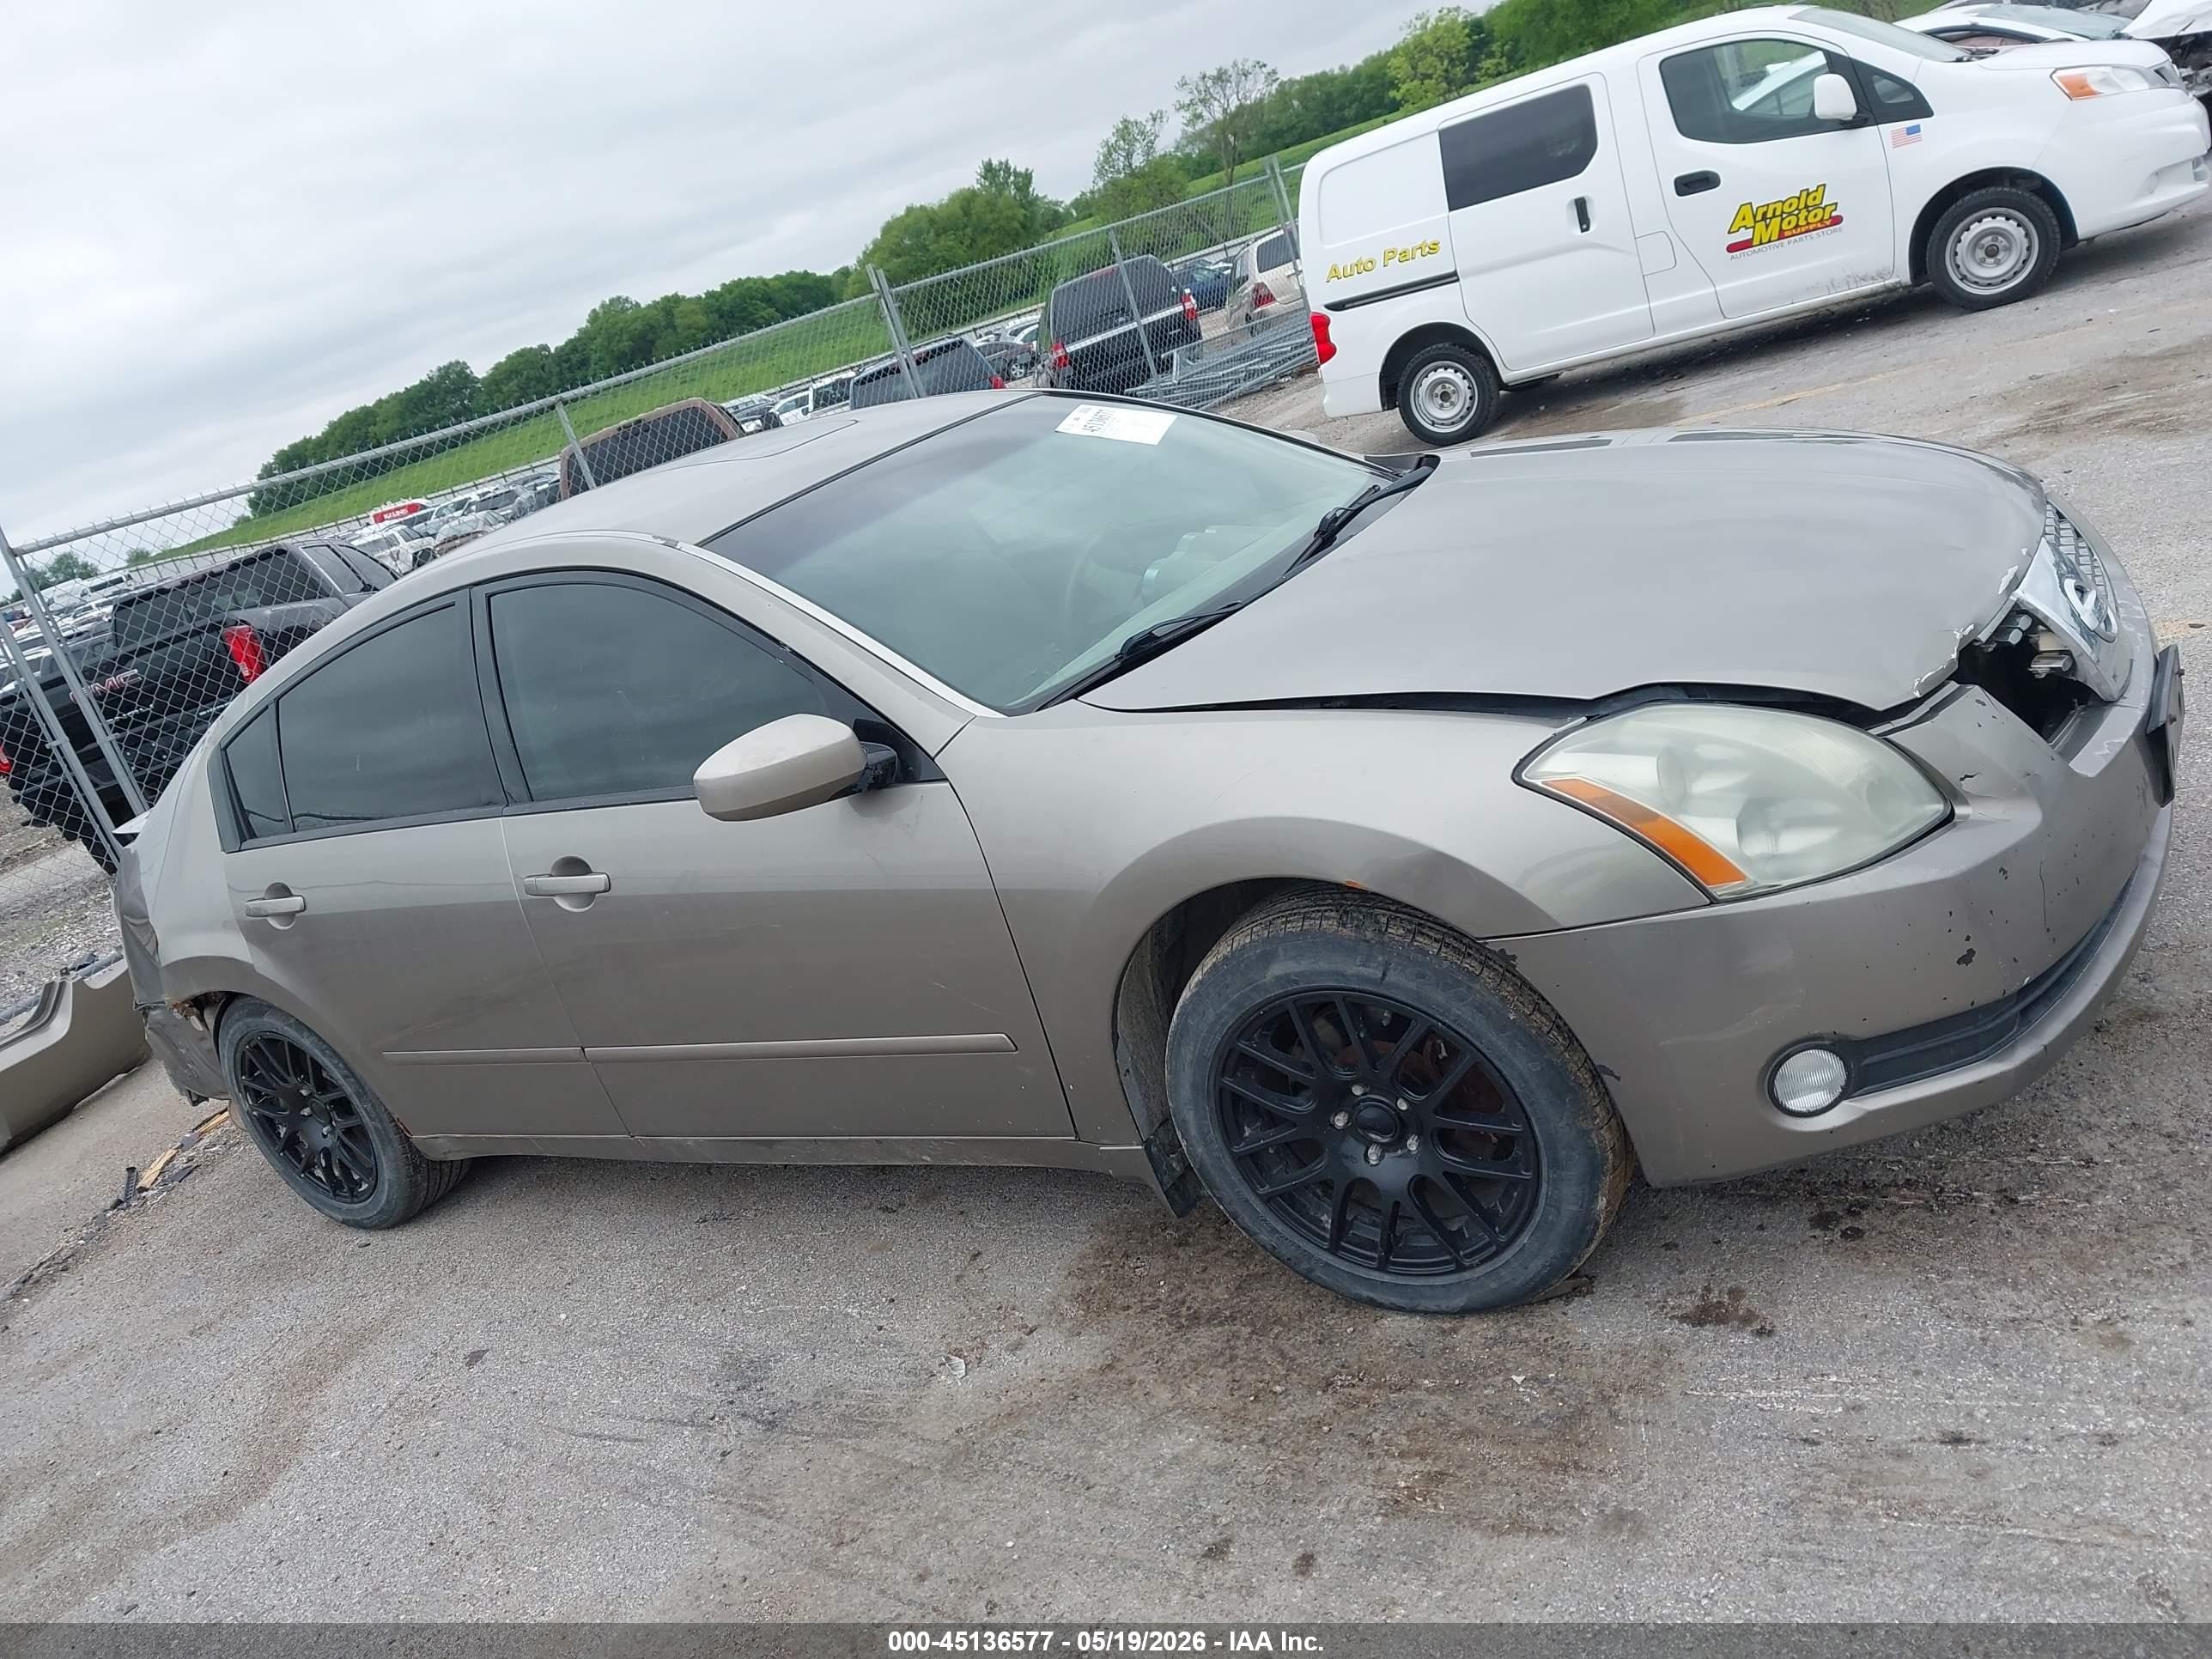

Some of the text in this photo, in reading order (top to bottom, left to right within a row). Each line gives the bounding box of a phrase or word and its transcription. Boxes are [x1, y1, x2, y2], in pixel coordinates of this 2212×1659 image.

[1728, 183, 1826, 234] Arnold
[1752, 202, 1838, 246] Motor
[1325, 240, 1441, 283] Auto Parts
[1729, 226, 1844, 261] AUTOMOTIVE PARTS STORE
